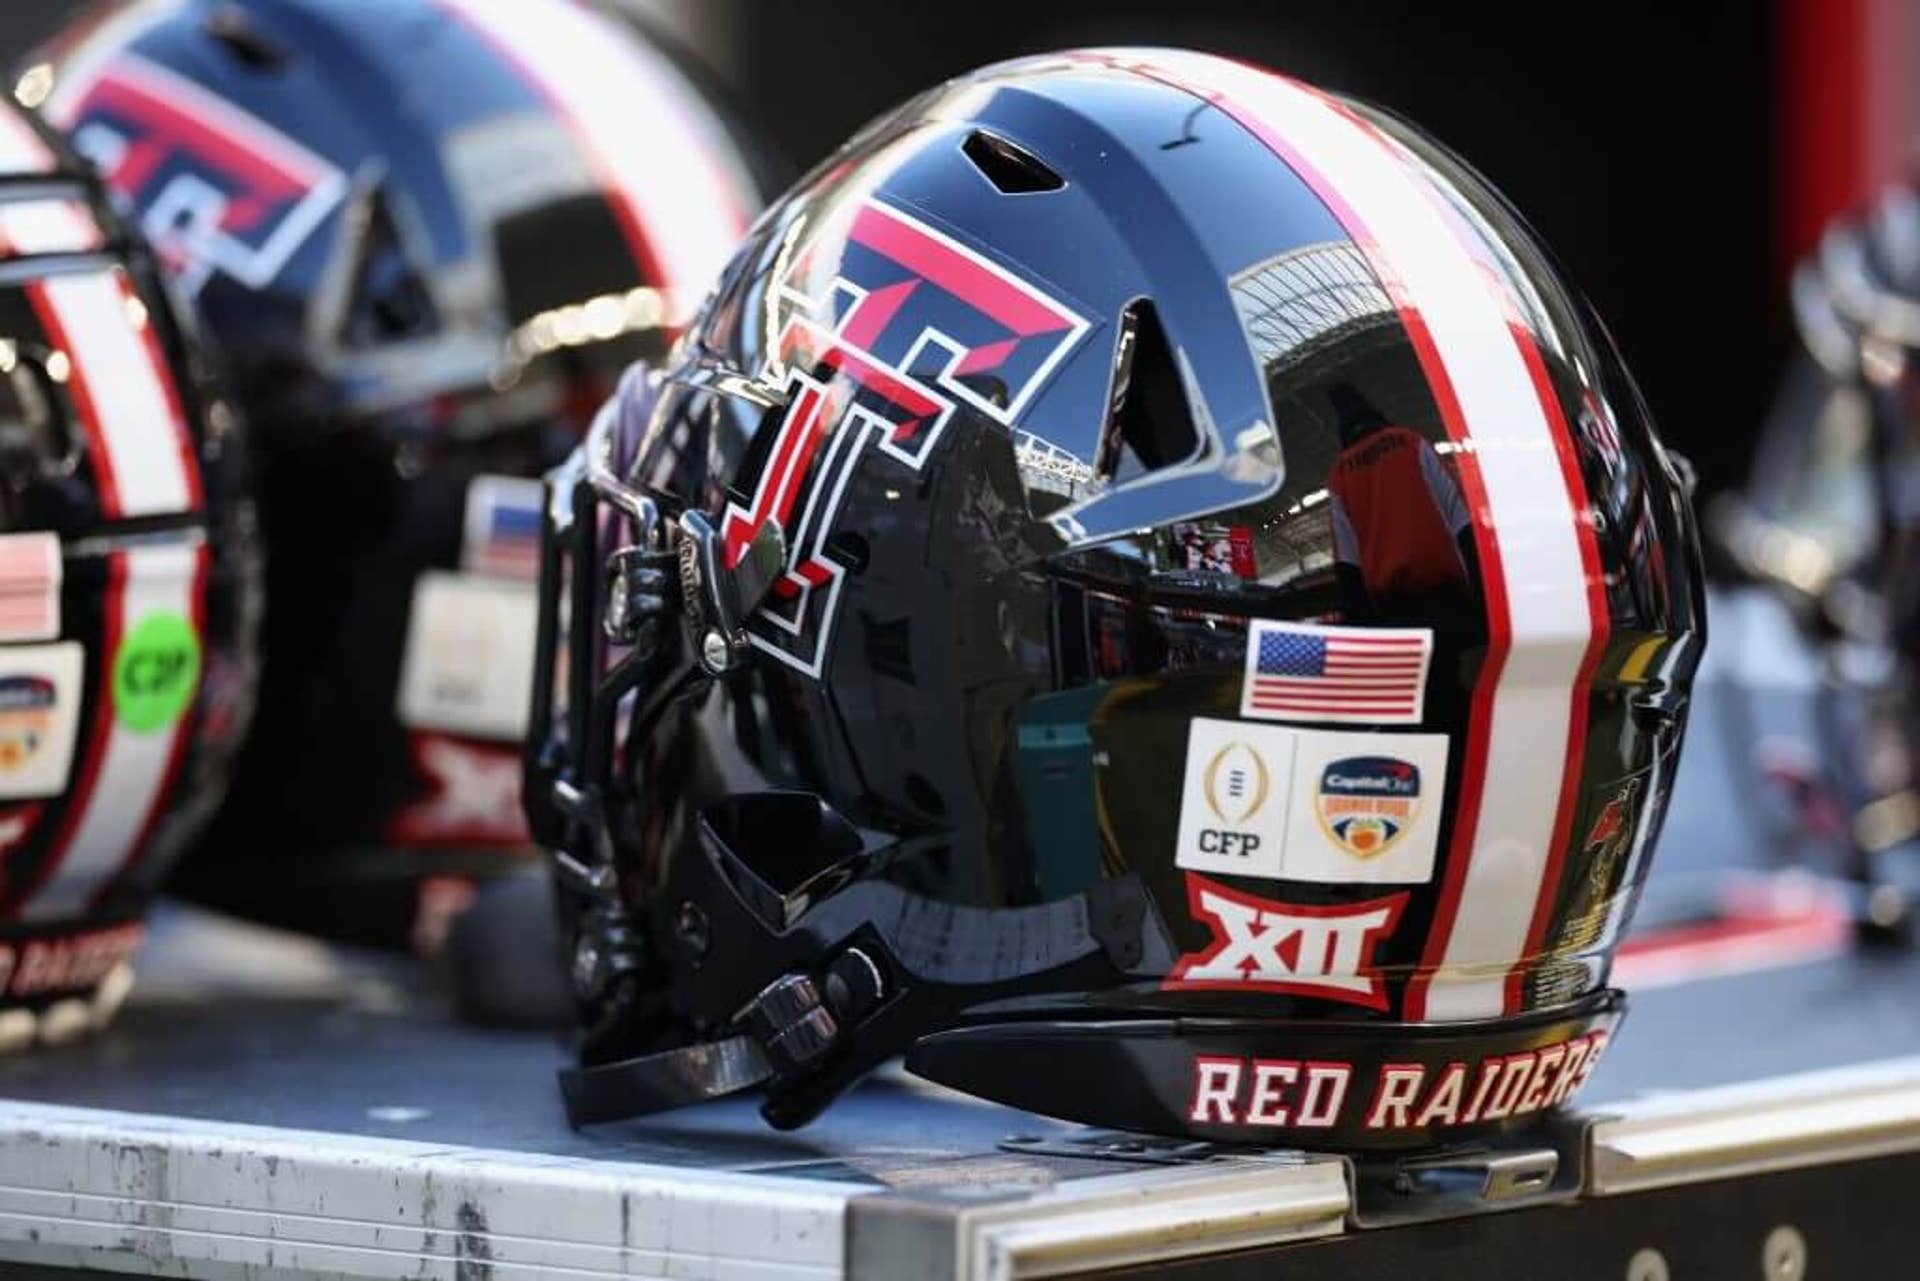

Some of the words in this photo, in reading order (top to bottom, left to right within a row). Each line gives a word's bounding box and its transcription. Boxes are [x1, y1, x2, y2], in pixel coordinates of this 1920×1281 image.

[1198, 828, 1261, 857] CFP
[1182, 890, 1393, 995] XII
[1190, 1054, 1352, 1129] RED
[1367, 1028, 1608, 1130] RAIDERS
